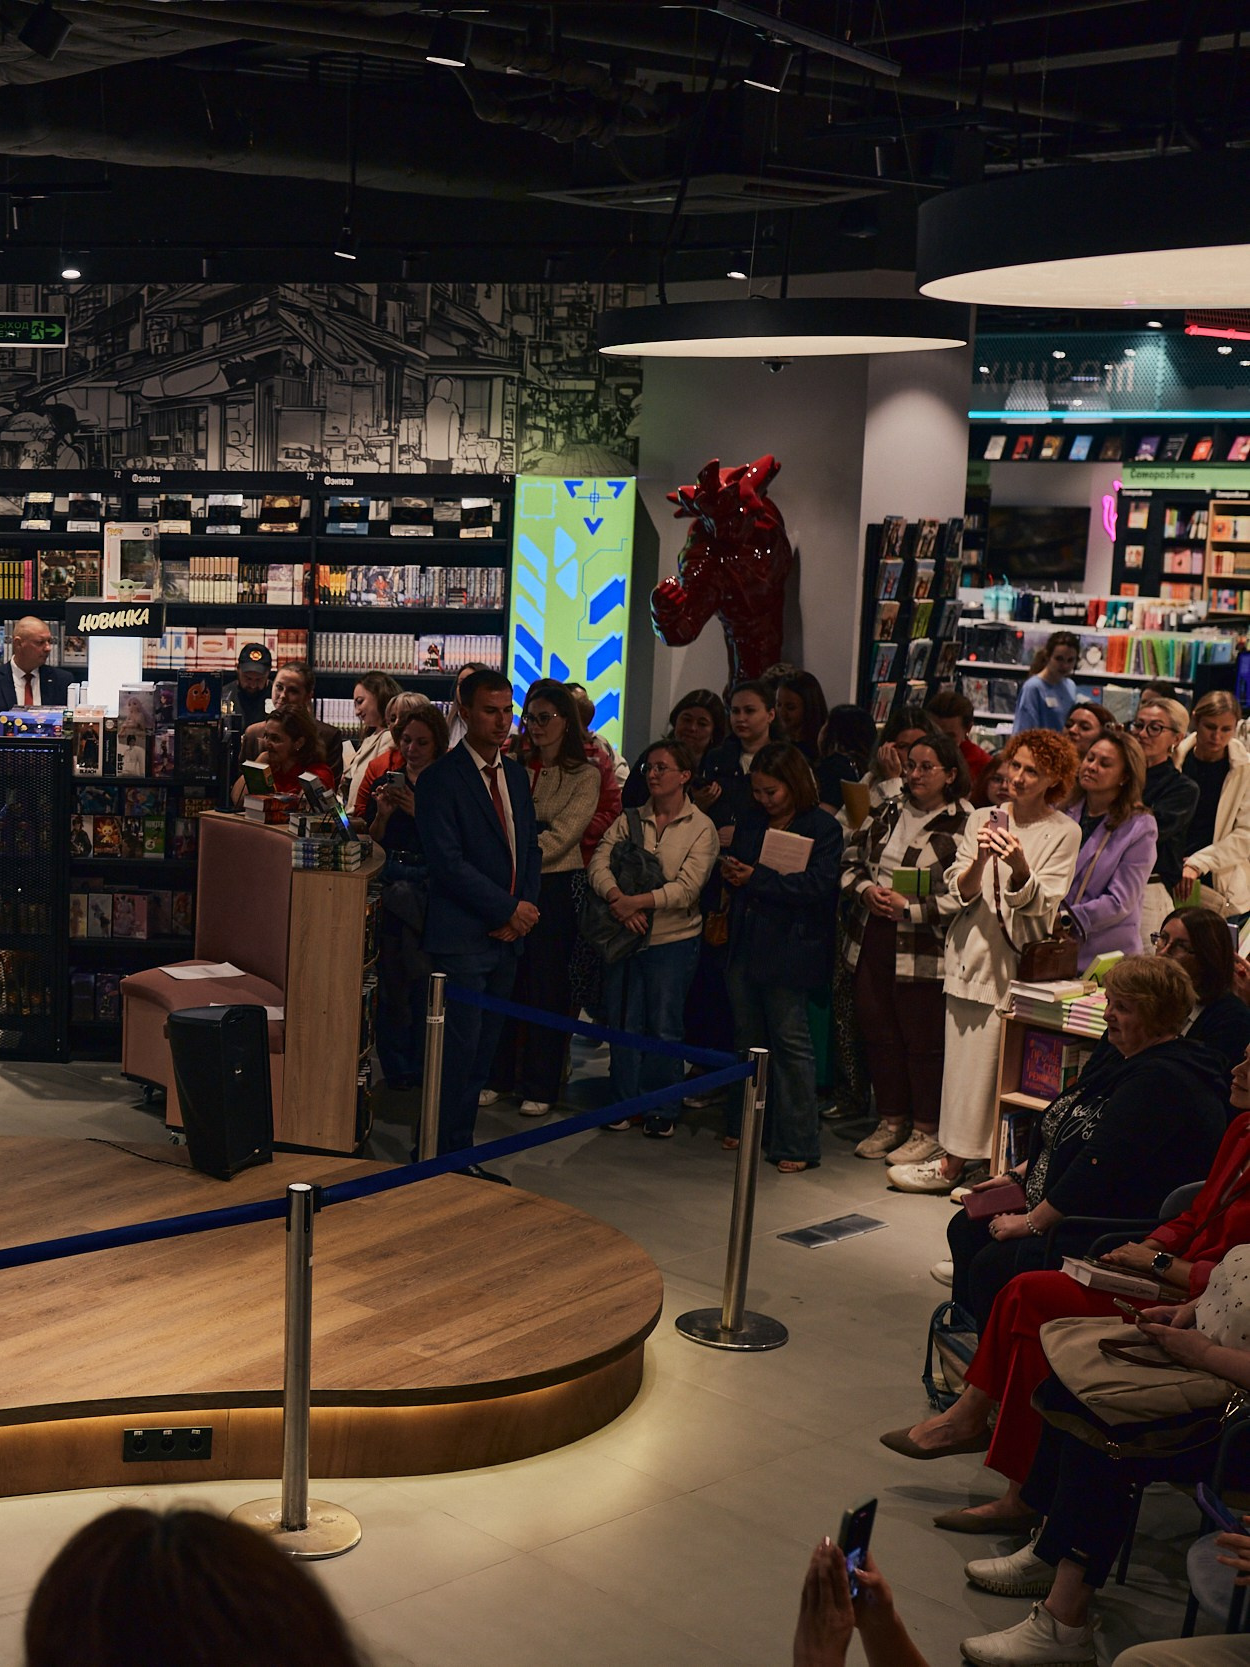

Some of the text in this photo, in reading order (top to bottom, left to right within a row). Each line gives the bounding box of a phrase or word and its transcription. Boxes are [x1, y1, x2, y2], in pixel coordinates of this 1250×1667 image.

[132, 473, 160, 483] Фэнтези
[324, 476, 353, 486] Фэнтези
[77, 608, 150, 632] НОВИНКА
